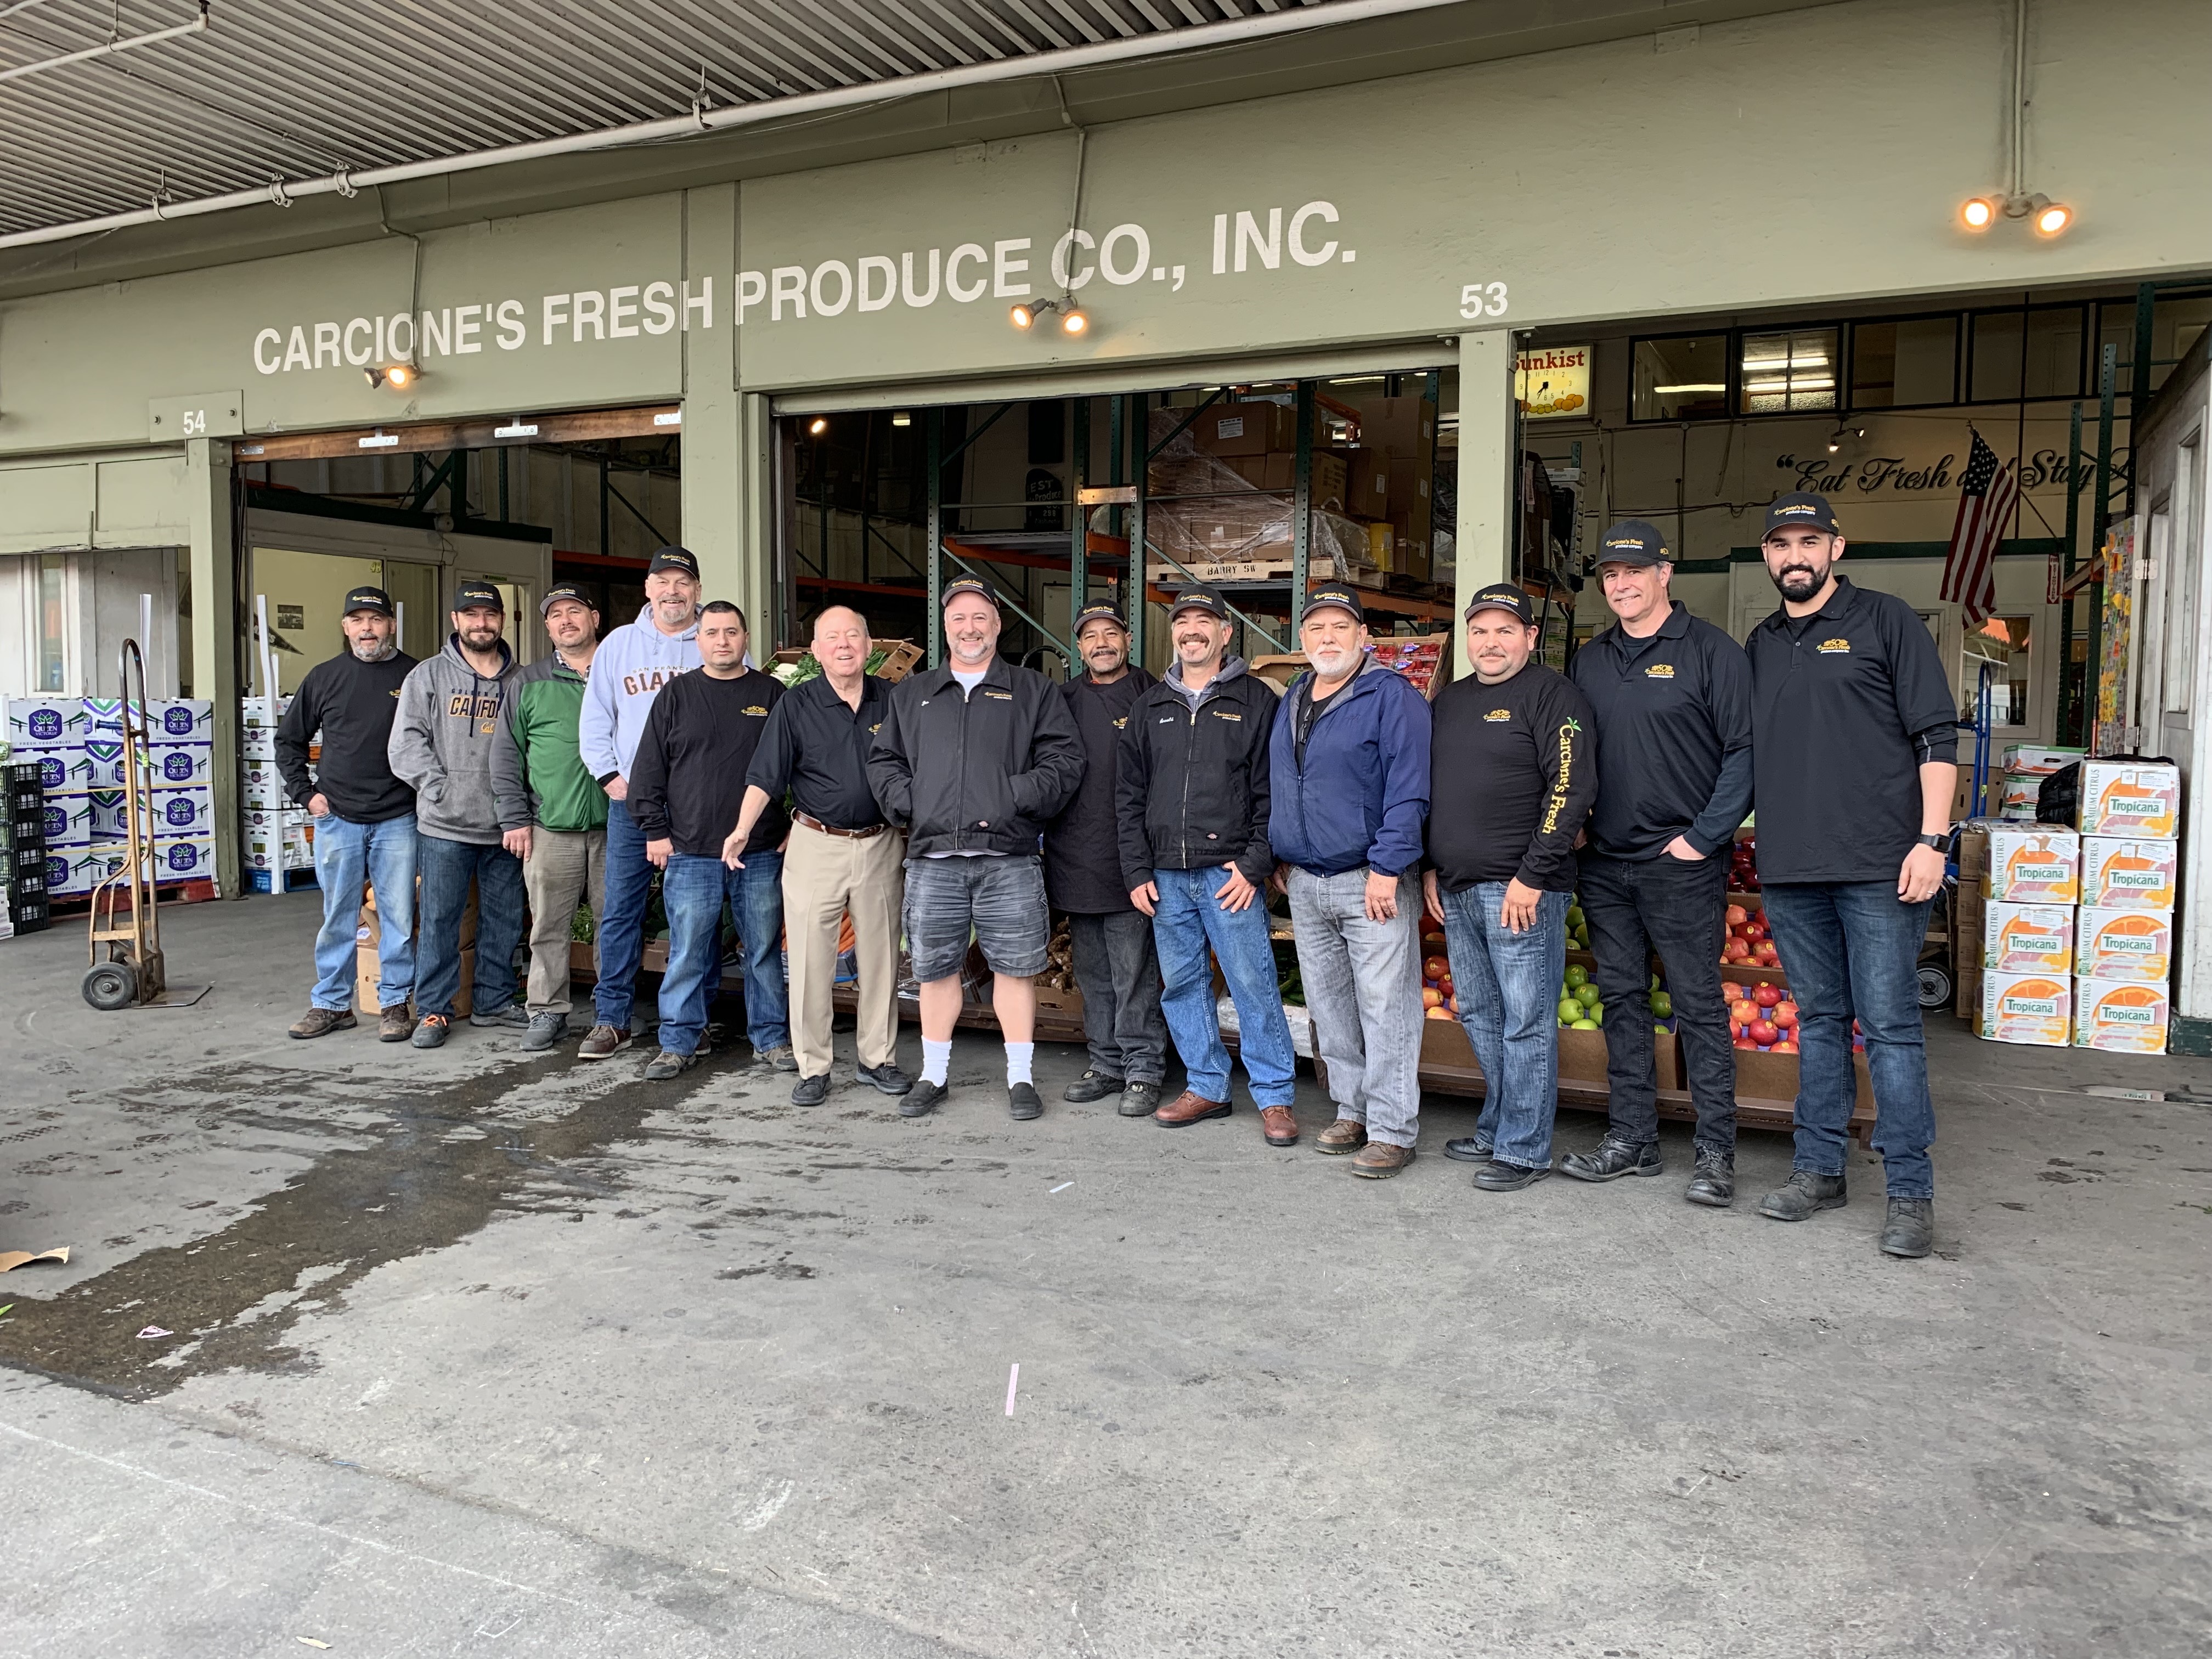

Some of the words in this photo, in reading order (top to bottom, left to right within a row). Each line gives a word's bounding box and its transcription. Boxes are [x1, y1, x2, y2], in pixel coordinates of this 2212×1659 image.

[254, 300, 526, 374] CARCIONE'S
[543, 276, 713, 345] FRESH
[735, 238, 1031, 325] PRODUCE
[1051, 224, 1186, 291] CO.,
[1213, 201, 1356, 274] INC.
[1460, 282, 1508, 319] 53
[1516, 350, 1584, 371] unkist
[183, 410, 206, 435] 54
[1857, 454, 1954, 494] Fresh
[1207, 566, 1237, 575] BARRY
[449, 695, 500, 719] CAIFO
[1555, 724, 1575, 793] Carcione's
[2090, 769, 2100, 795] CITRUS
[1542, 794, 1566, 834] Fresh
[2086, 798, 2097, 833] PREMIUM
[2111, 799, 2159, 812] Tropicana
[1996, 838, 2005, 863] CITRUS
[2090, 842, 2099, 868] CITRUS
[1995, 865, 2004, 899] PREMIUM
[2017, 866, 2063, 879] Tropicana
[2111, 872, 2159, 886] Tropicana
[2087, 871, 2097, 906] PREMIUM
[1990, 907, 1999, 932] CITRUS
[2083, 912, 2092, 938] CITRUS
[1989, 934, 1998, 968] PREMIUM
[2010, 936, 2057, 950] Tropicana
[2103, 936, 2152, 950] Tropicana
[2081, 940, 2091, 975] PREMIUM
[1987, 975, 1995, 1001] CITRUS
[2082, 983, 2091, 1009] CITRUS
[2006, 999, 2053, 1013] Tropicana
[2102, 1007, 2150, 1021] Tropicana
[1986, 1003, 1995, 1037] PREMIUM
[2080, 1011, 2090, 1046] PREMIUM
